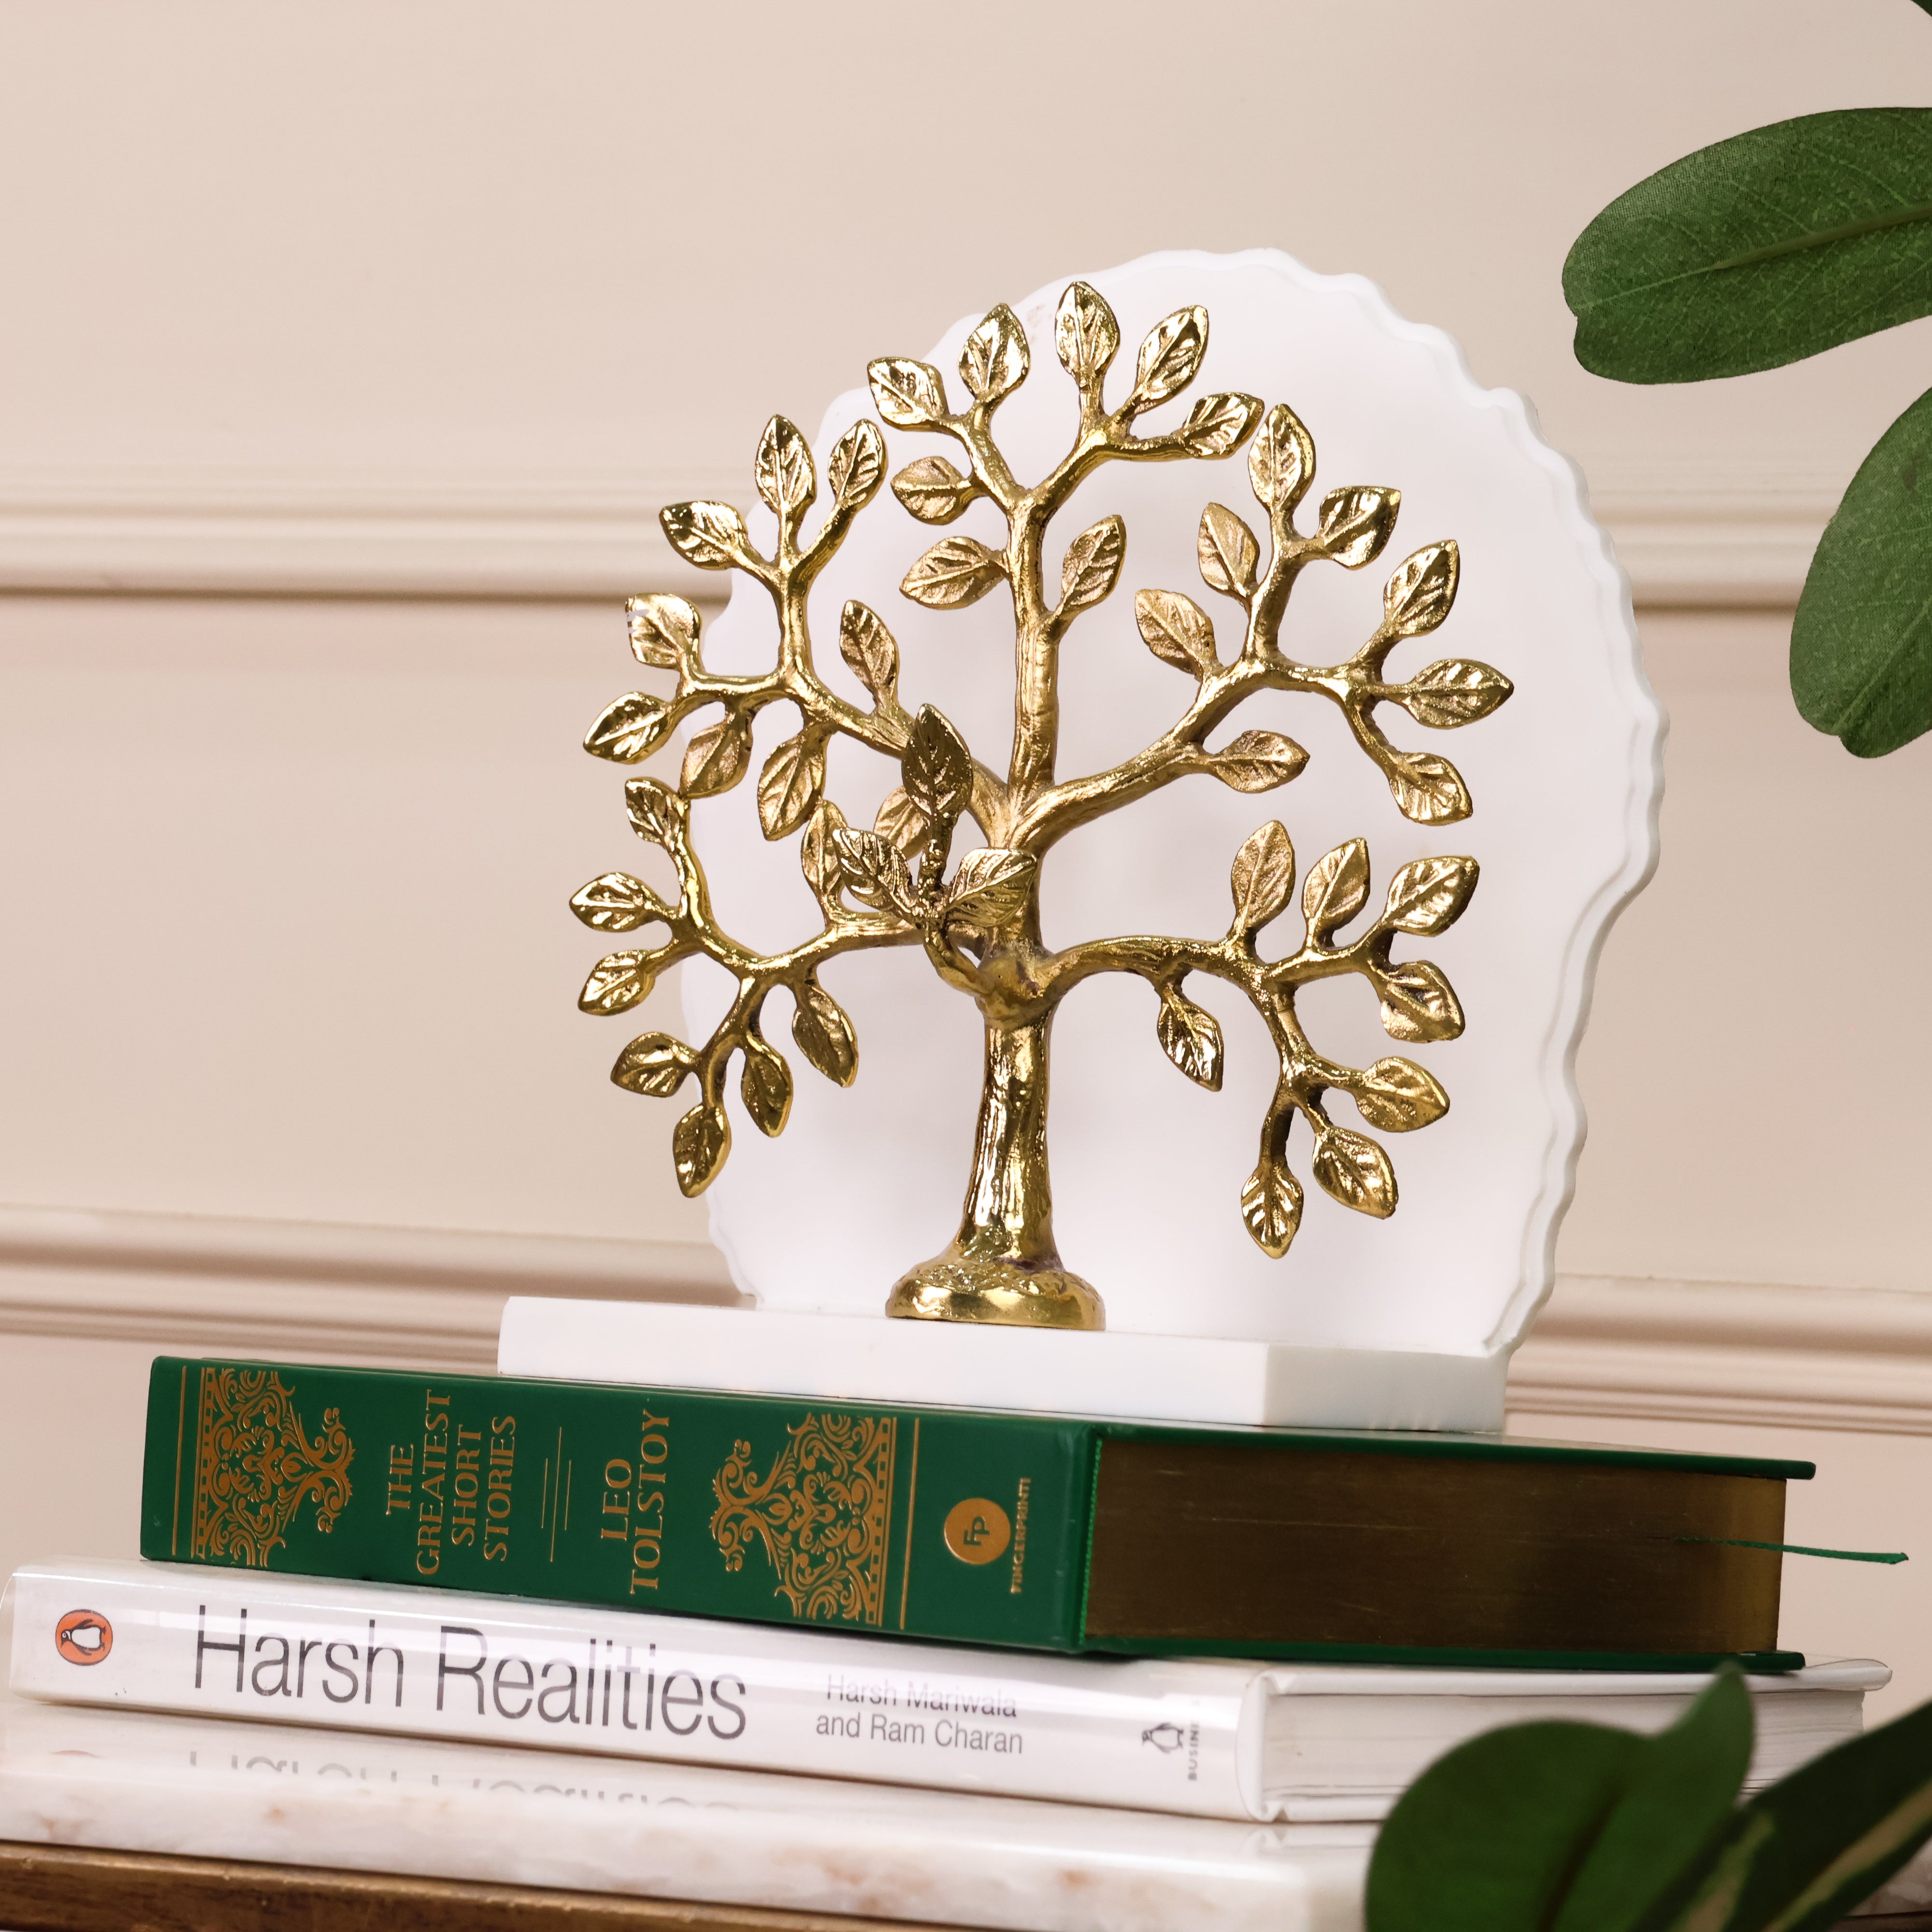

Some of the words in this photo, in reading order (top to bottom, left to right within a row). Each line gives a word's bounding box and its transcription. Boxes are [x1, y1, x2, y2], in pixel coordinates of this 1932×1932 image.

[386, 1444, 414, 1515] THE
[416, 1389, 450, 1575] GREATEST
[451, 1424, 481, 1546] SHORT
[484, 1415, 516, 1562] STORIES
[600, 1459, 632, 1541] LEO
[630, 1408, 670, 1594] TOLSTOY
[195, 1605, 405, 1707] Harsh
[437, 1625, 746, 1739] Realities
[815, 1711, 861, 1738] and
[870, 1712, 925, 1745] Ram
[935, 1718, 1023, 1755] Charan
[826, 1673, 897, 1707] Harsh
[907, 1680, 1018, 1719] Mariwala
